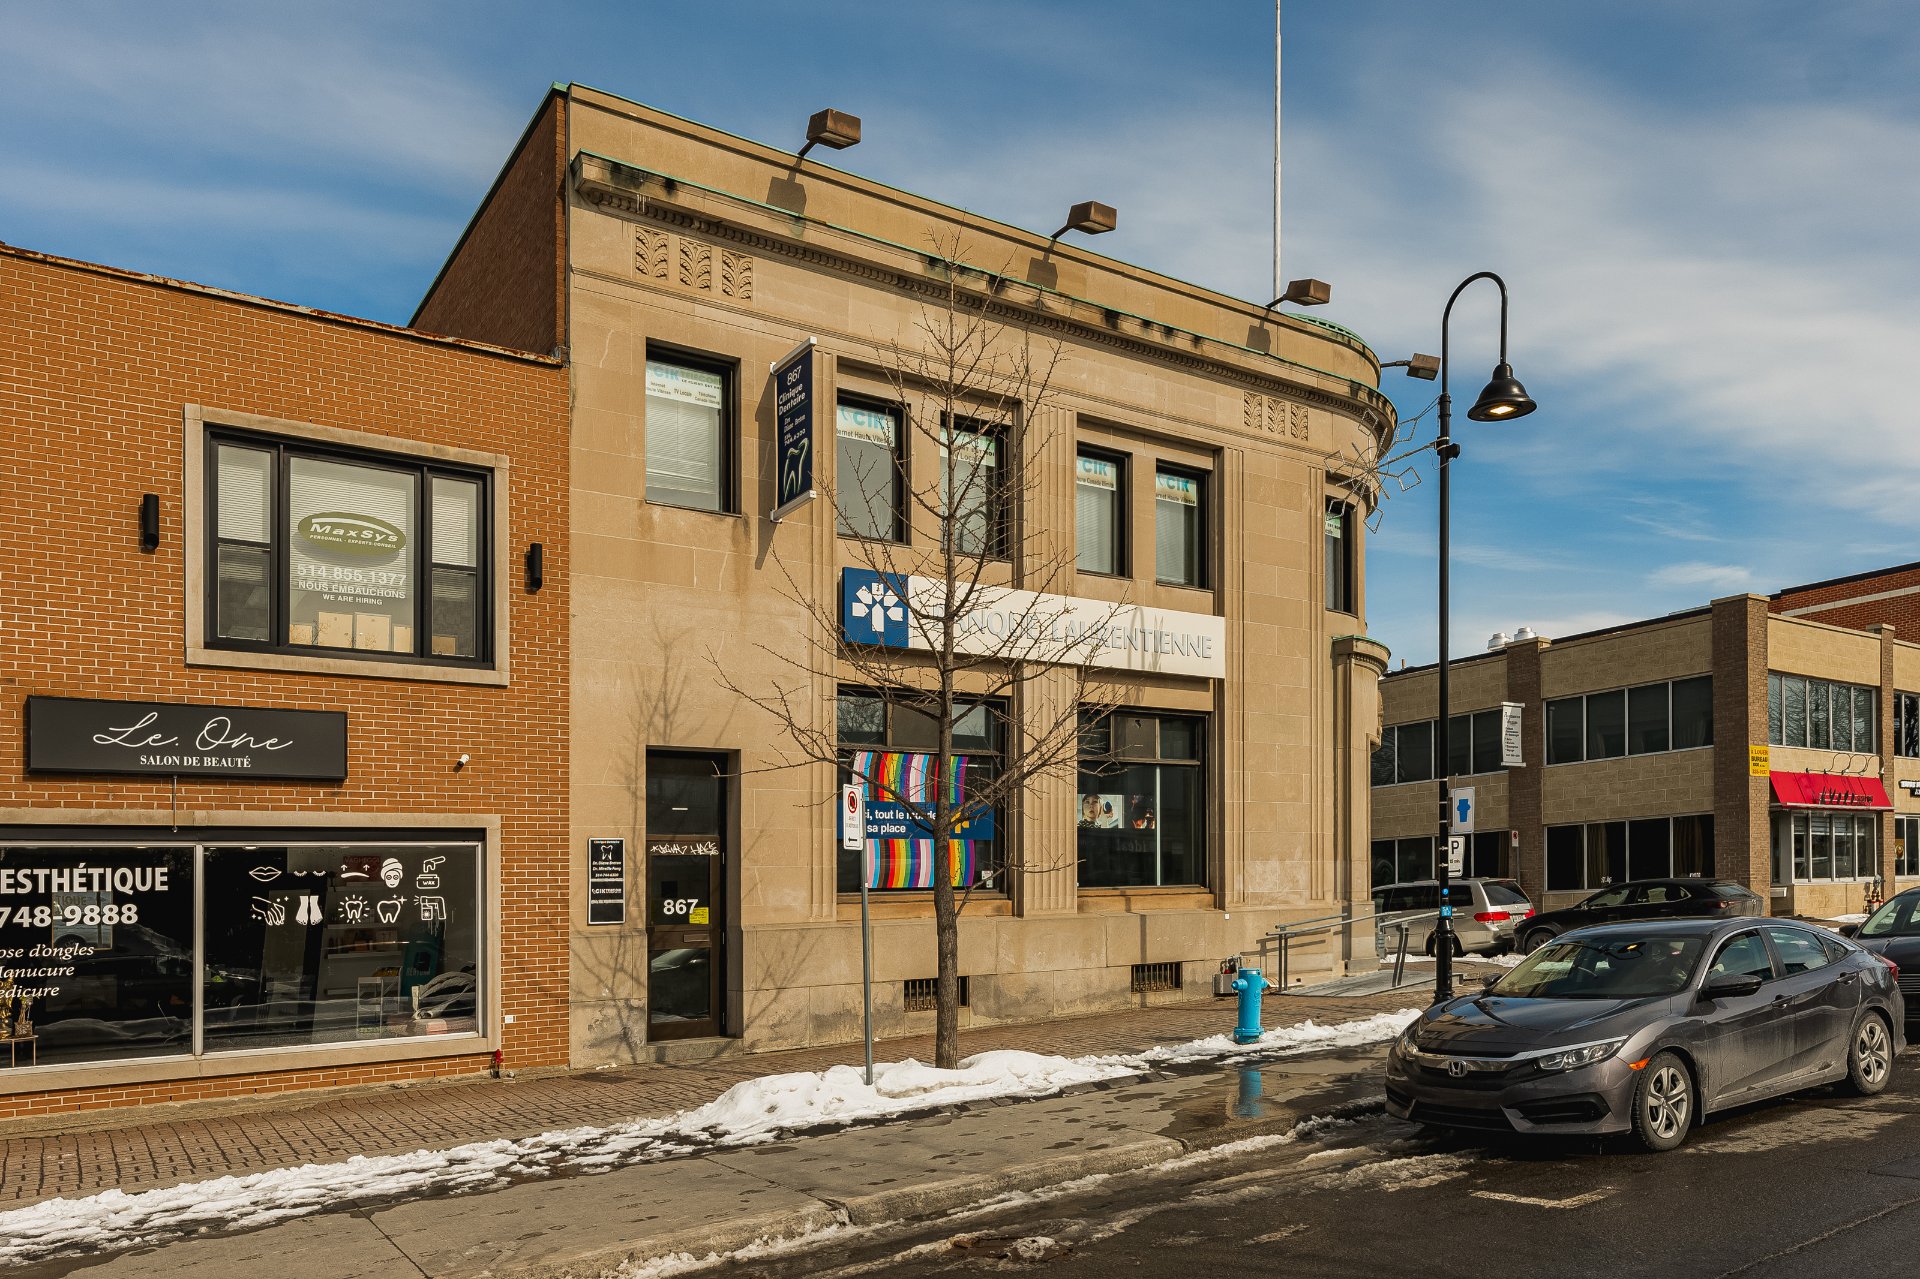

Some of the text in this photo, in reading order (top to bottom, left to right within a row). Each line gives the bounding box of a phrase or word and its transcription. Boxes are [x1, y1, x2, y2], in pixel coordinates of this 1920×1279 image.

[787, 365, 802, 386] 867
[778, 383, 803, 405] Clinique
[778, 392, 806, 416] Dentaire
[1082, 458, 1108, 476] CIK
[1167, 476, 1190, 492] CIK
[310, 523, 399, 542] MaxSys
[297, 563, 407, 586] 514.855.1377
[298, 580, 406, 599] NOUS EMBAUCHONS
[322, 593, 336, 601] WE
[355, 597, 383, 605] HIRING
[1051, 618, 1212, 659] LAURENTIENNE
[195, 716, 294, 751] One
[140, 755, 251, 768] SALON DE BEAUTÉ
[874, 809, 894, 820] tout
[895, 809, 905, 820] le
[866, 824, 878, 833] sa
[880, 823, 906, 835] place
[1451, 840, 1460, 854] P
[0, 862, 169, 895] ESTHÉTIQUE
[0, 903, 139, 928] 748-9888
[663, 898, 699, 915] 867
